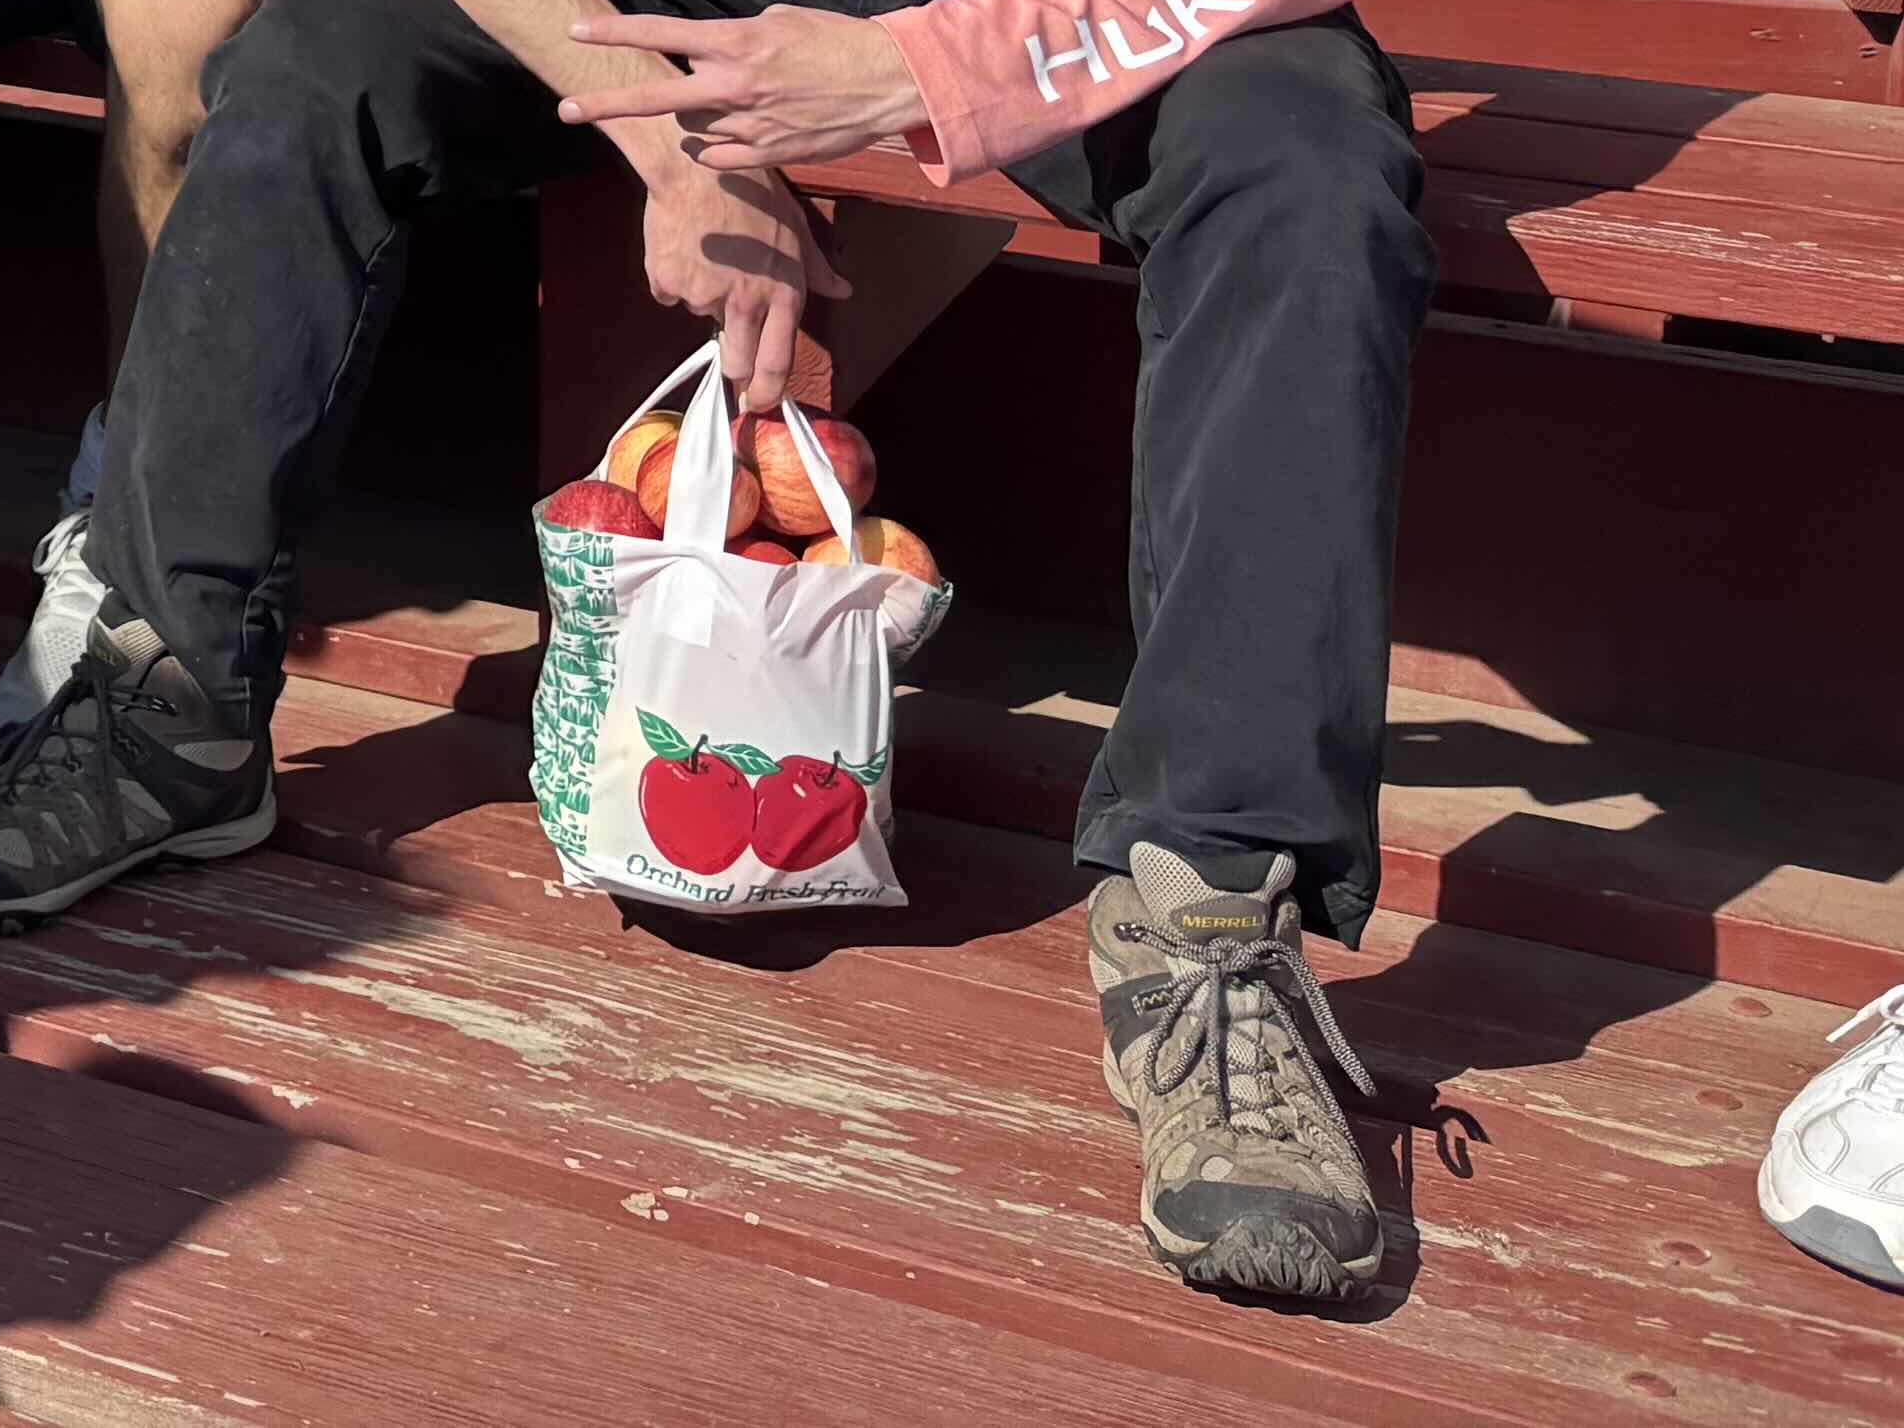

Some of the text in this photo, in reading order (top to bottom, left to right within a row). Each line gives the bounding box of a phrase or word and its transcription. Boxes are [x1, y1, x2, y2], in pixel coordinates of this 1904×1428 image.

[626, 853, 887, 903] Orchard Fresh Fruit
